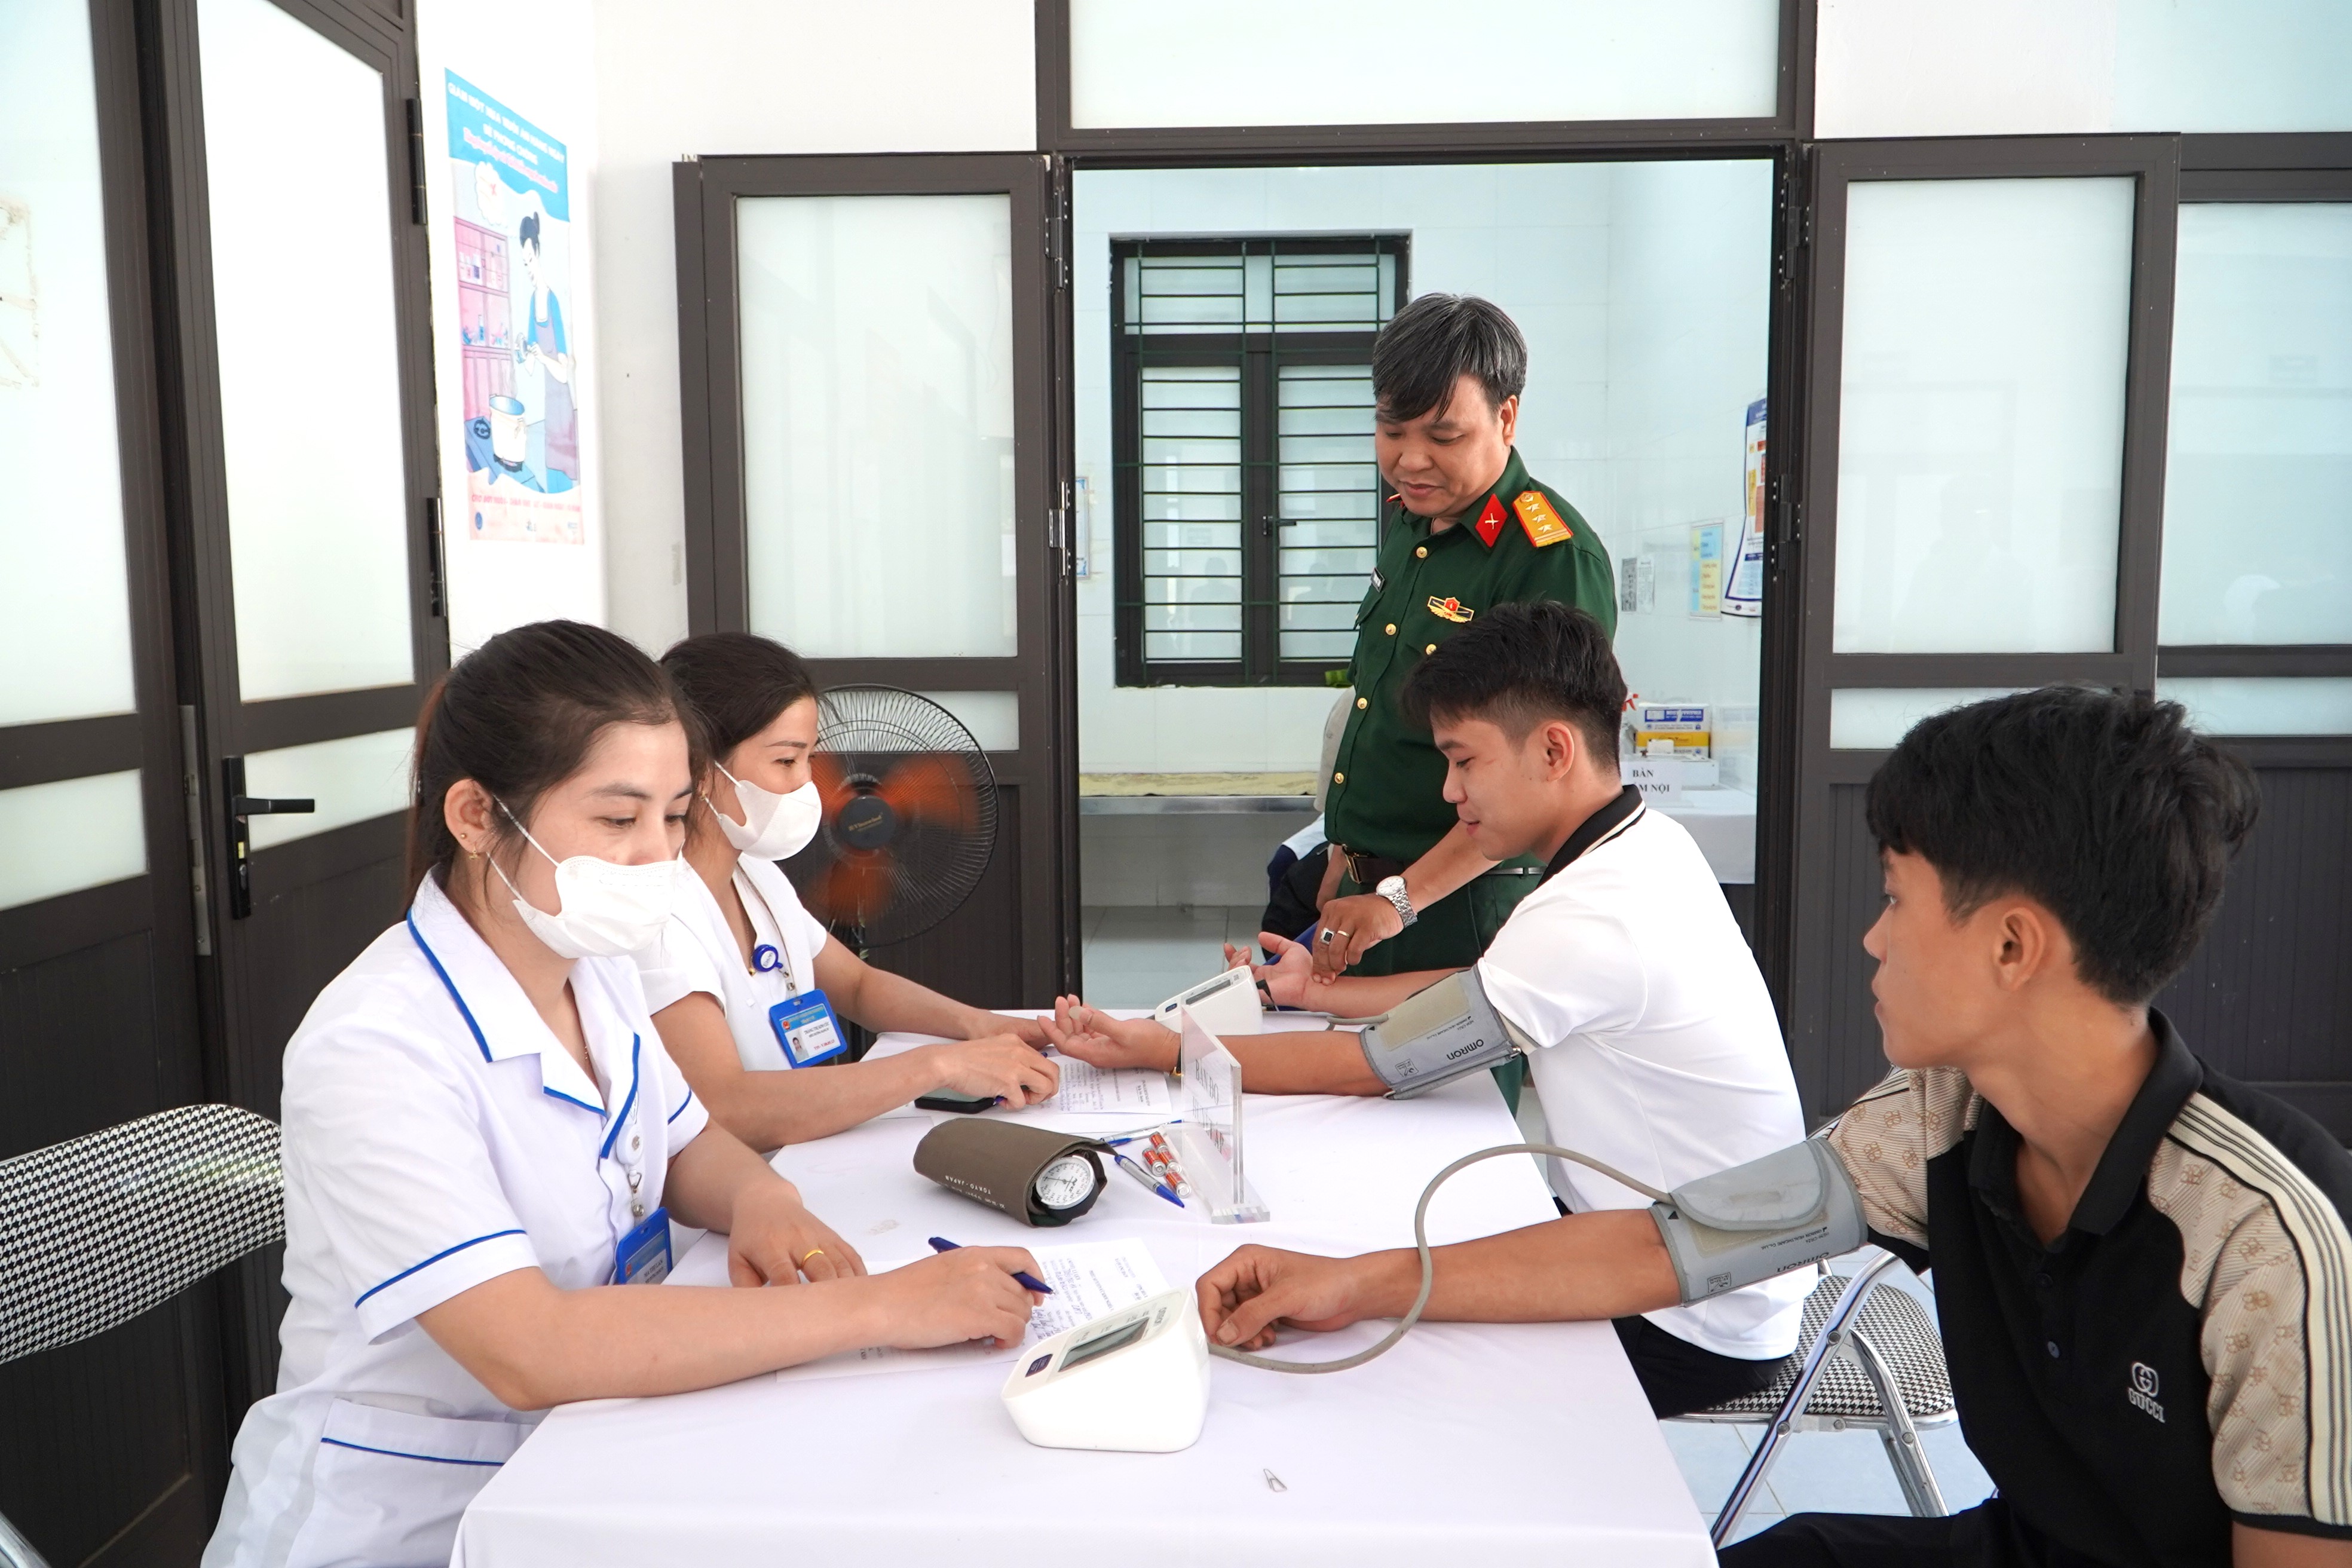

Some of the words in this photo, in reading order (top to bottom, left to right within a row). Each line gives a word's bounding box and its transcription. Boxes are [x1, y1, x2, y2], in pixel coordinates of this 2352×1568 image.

[1633, 767, 1654, 777] BÀN
[1651, 783, 1670, 794] NỘI
[945, 1175, 965, 1186] JAPAN
[969, 1183, 991, 1195] TOKYO
[2128, 1386, 2166, 1423] GUCCI
